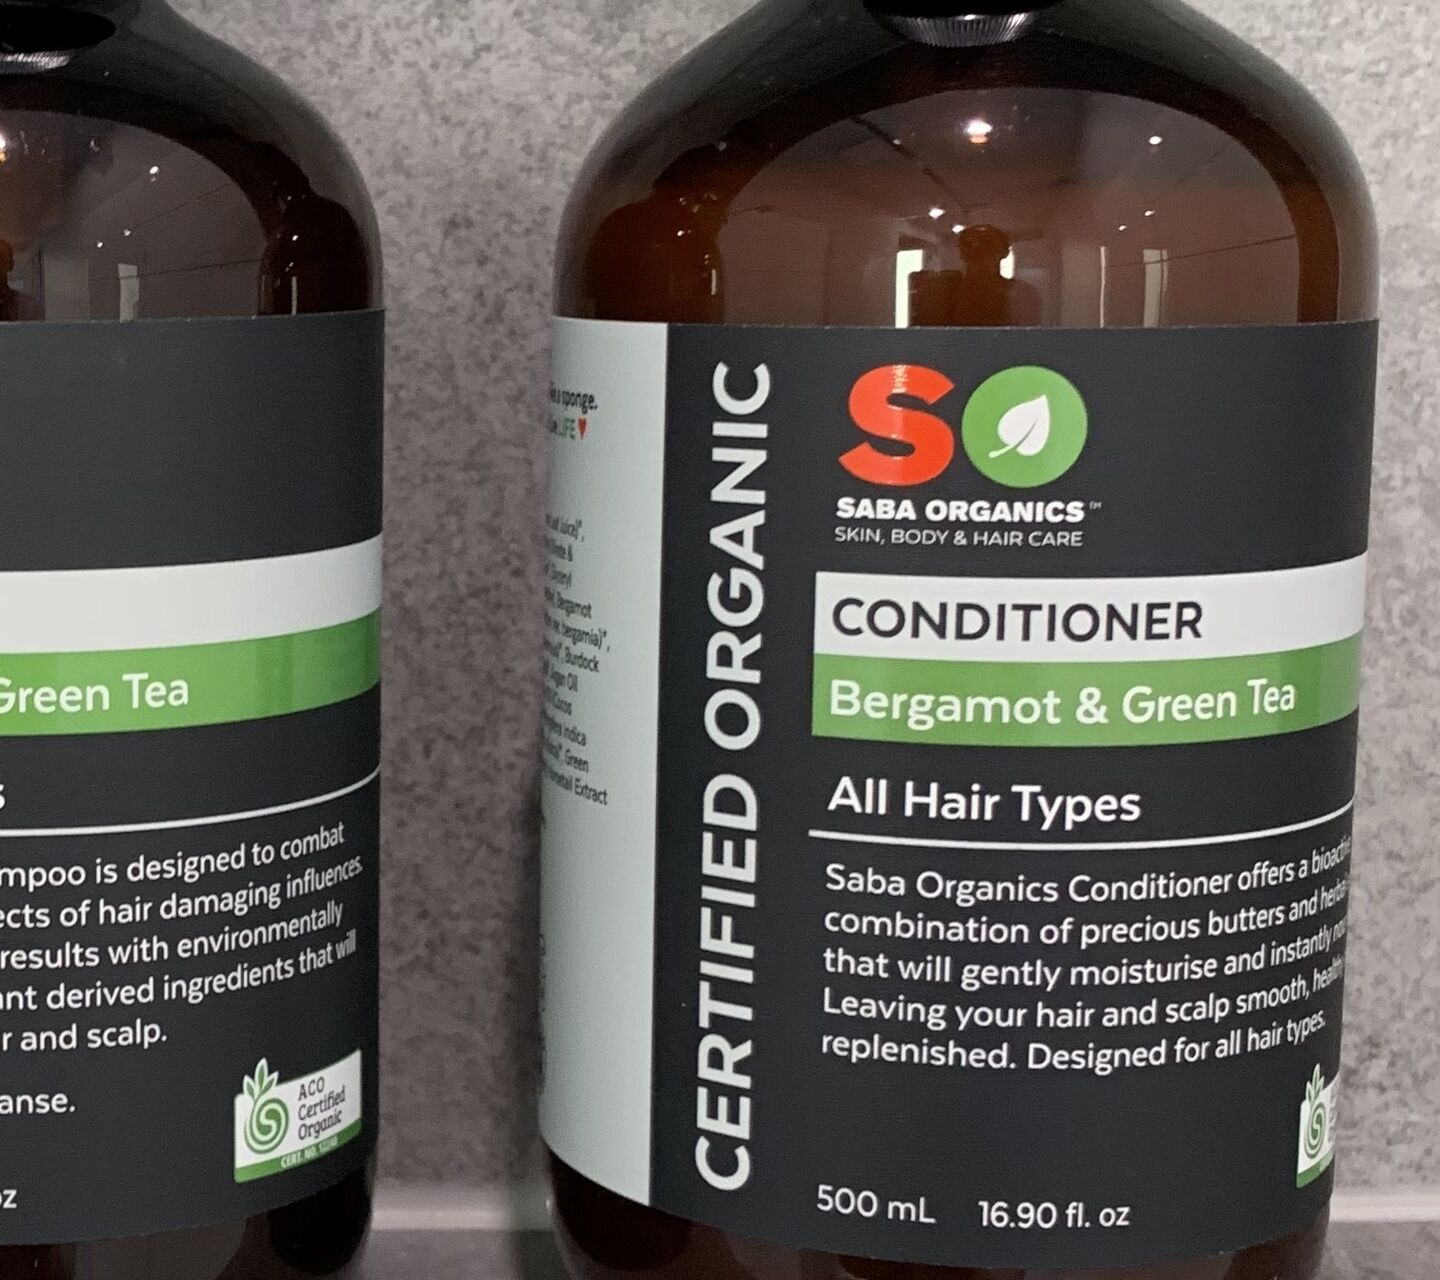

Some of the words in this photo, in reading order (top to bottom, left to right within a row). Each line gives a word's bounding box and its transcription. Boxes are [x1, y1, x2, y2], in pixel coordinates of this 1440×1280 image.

[836, 496, 917, 521] SABA
[924, 499, 1085, 523] ORGANICS
[704, 361, 771, 751] ORGANIC
[834, 526, 885, 545] SKIN,
[890, 528, 950, 545] BODY
[953, 530, 968, 546] &
[973, 530, 1024, 546] HAIR
[1028, 530, 1083, 547] CARE
[832, 597, 1203, 643] CONDITIONER
[121, 672, 189, 709] Tea
[830, 678, 1062, 731] Bergamot
[1075, 686, 1109, 725] &
[1122, 685, 1237, 724] Green
[1246, 677, 1296, 715] Tea
[574, 776, 608, 805] Extract
[827, 775, 888, 815] All
[904, 780, 1001, 821] Hair
[1010, 784, 1141, 831] Types
[95, 857, 118, 884] is
[126, 842, 246, 883] designed
[251, 842, 275, 866] to
[279, 821, 345, 861] combat
[826, 863, 906, 896] Saba
[916, 870, 1059, 908] Organics
[1068, 871, 1233, 903] Conditioner
[1237, 860, 1295, 891] offers
[1297, 859, 1309, 879] a
[0, 941, 100, 970] results
[107, 935, 169, 965] with
[176, 899, 343, 959] environmentally
[824, 910, 1030, 944] combination
[1039, 916, 1075, 945] of
[1080, 914, 1201, 950] precious
[1207, 905, 1285, 936] butters
[1288, 889, 1319, 922] and
[46, 976, 154, 1010] derived
[163, 957, 295, 1005] ingredients
[298, 942, 334, 974] that
[335, 928, 357, 960] will
[695, 773, 758, 1191] CERTIFIED
[20, 1022, 77, 1052] and
[86, 1017, 167, 1050] scalp.
[822, 1033, 1016, 1069] replenished.
[1027, 1038, 1167, 1076] Designed
[1173, 1036, 1211, 1063] for
[1214, 1028, 1242, 1059] all
[1246, 1021, 1284, 1052] hair
[297, 1076, 325, 1101] ACO
[297, 1084, 346, 1121] Certified
[297, 1109, 342, 1141] Organic
[816, 1184, 879, 1218] 500
[887, 1196, 936, 1224] mL
[978, 1200, 1058, 1229] 16.90
[1065, 1201, 1091, 1228] fl.
[1098, 1206, 1131, 1227] oz
